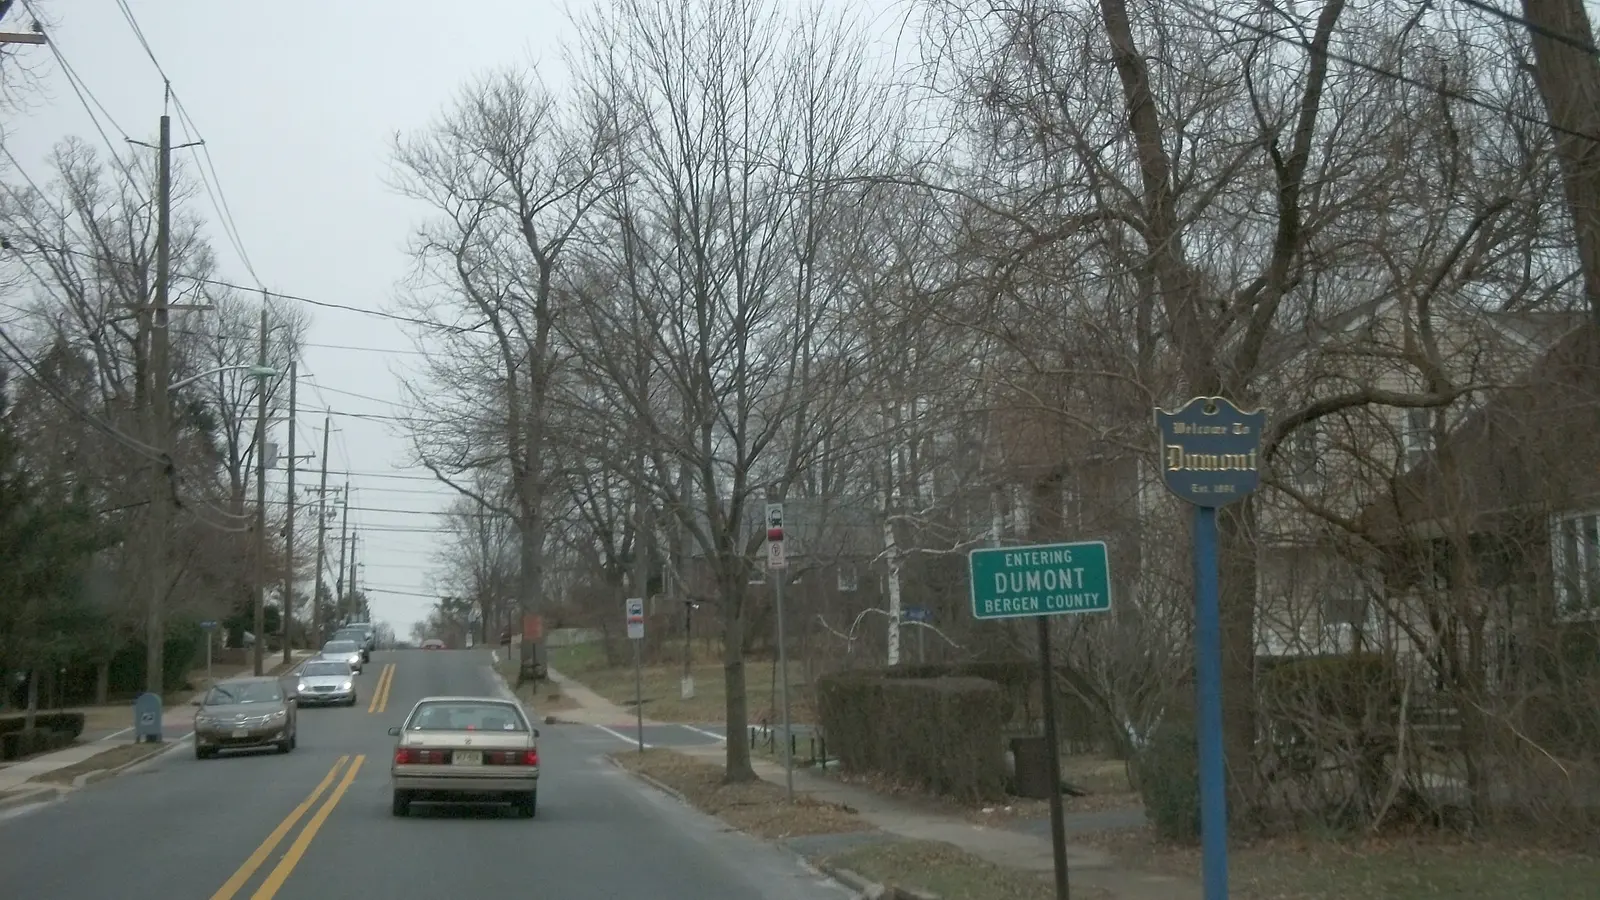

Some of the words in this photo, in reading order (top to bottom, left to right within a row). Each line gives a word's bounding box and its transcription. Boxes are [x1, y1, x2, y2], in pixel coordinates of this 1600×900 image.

[1173, 422, 1227, 434] Welcome
[1232, 422, 1250, 434] To
[1167, 445, 1257, 471] Dumont
[1005, 550, 1072, 567] ENTERING
[995, 567, 1084, 594] DUMONT
[984, 597, 1039, 613] BERGEN
[1046, 593, 1100, 609] COUNTY
